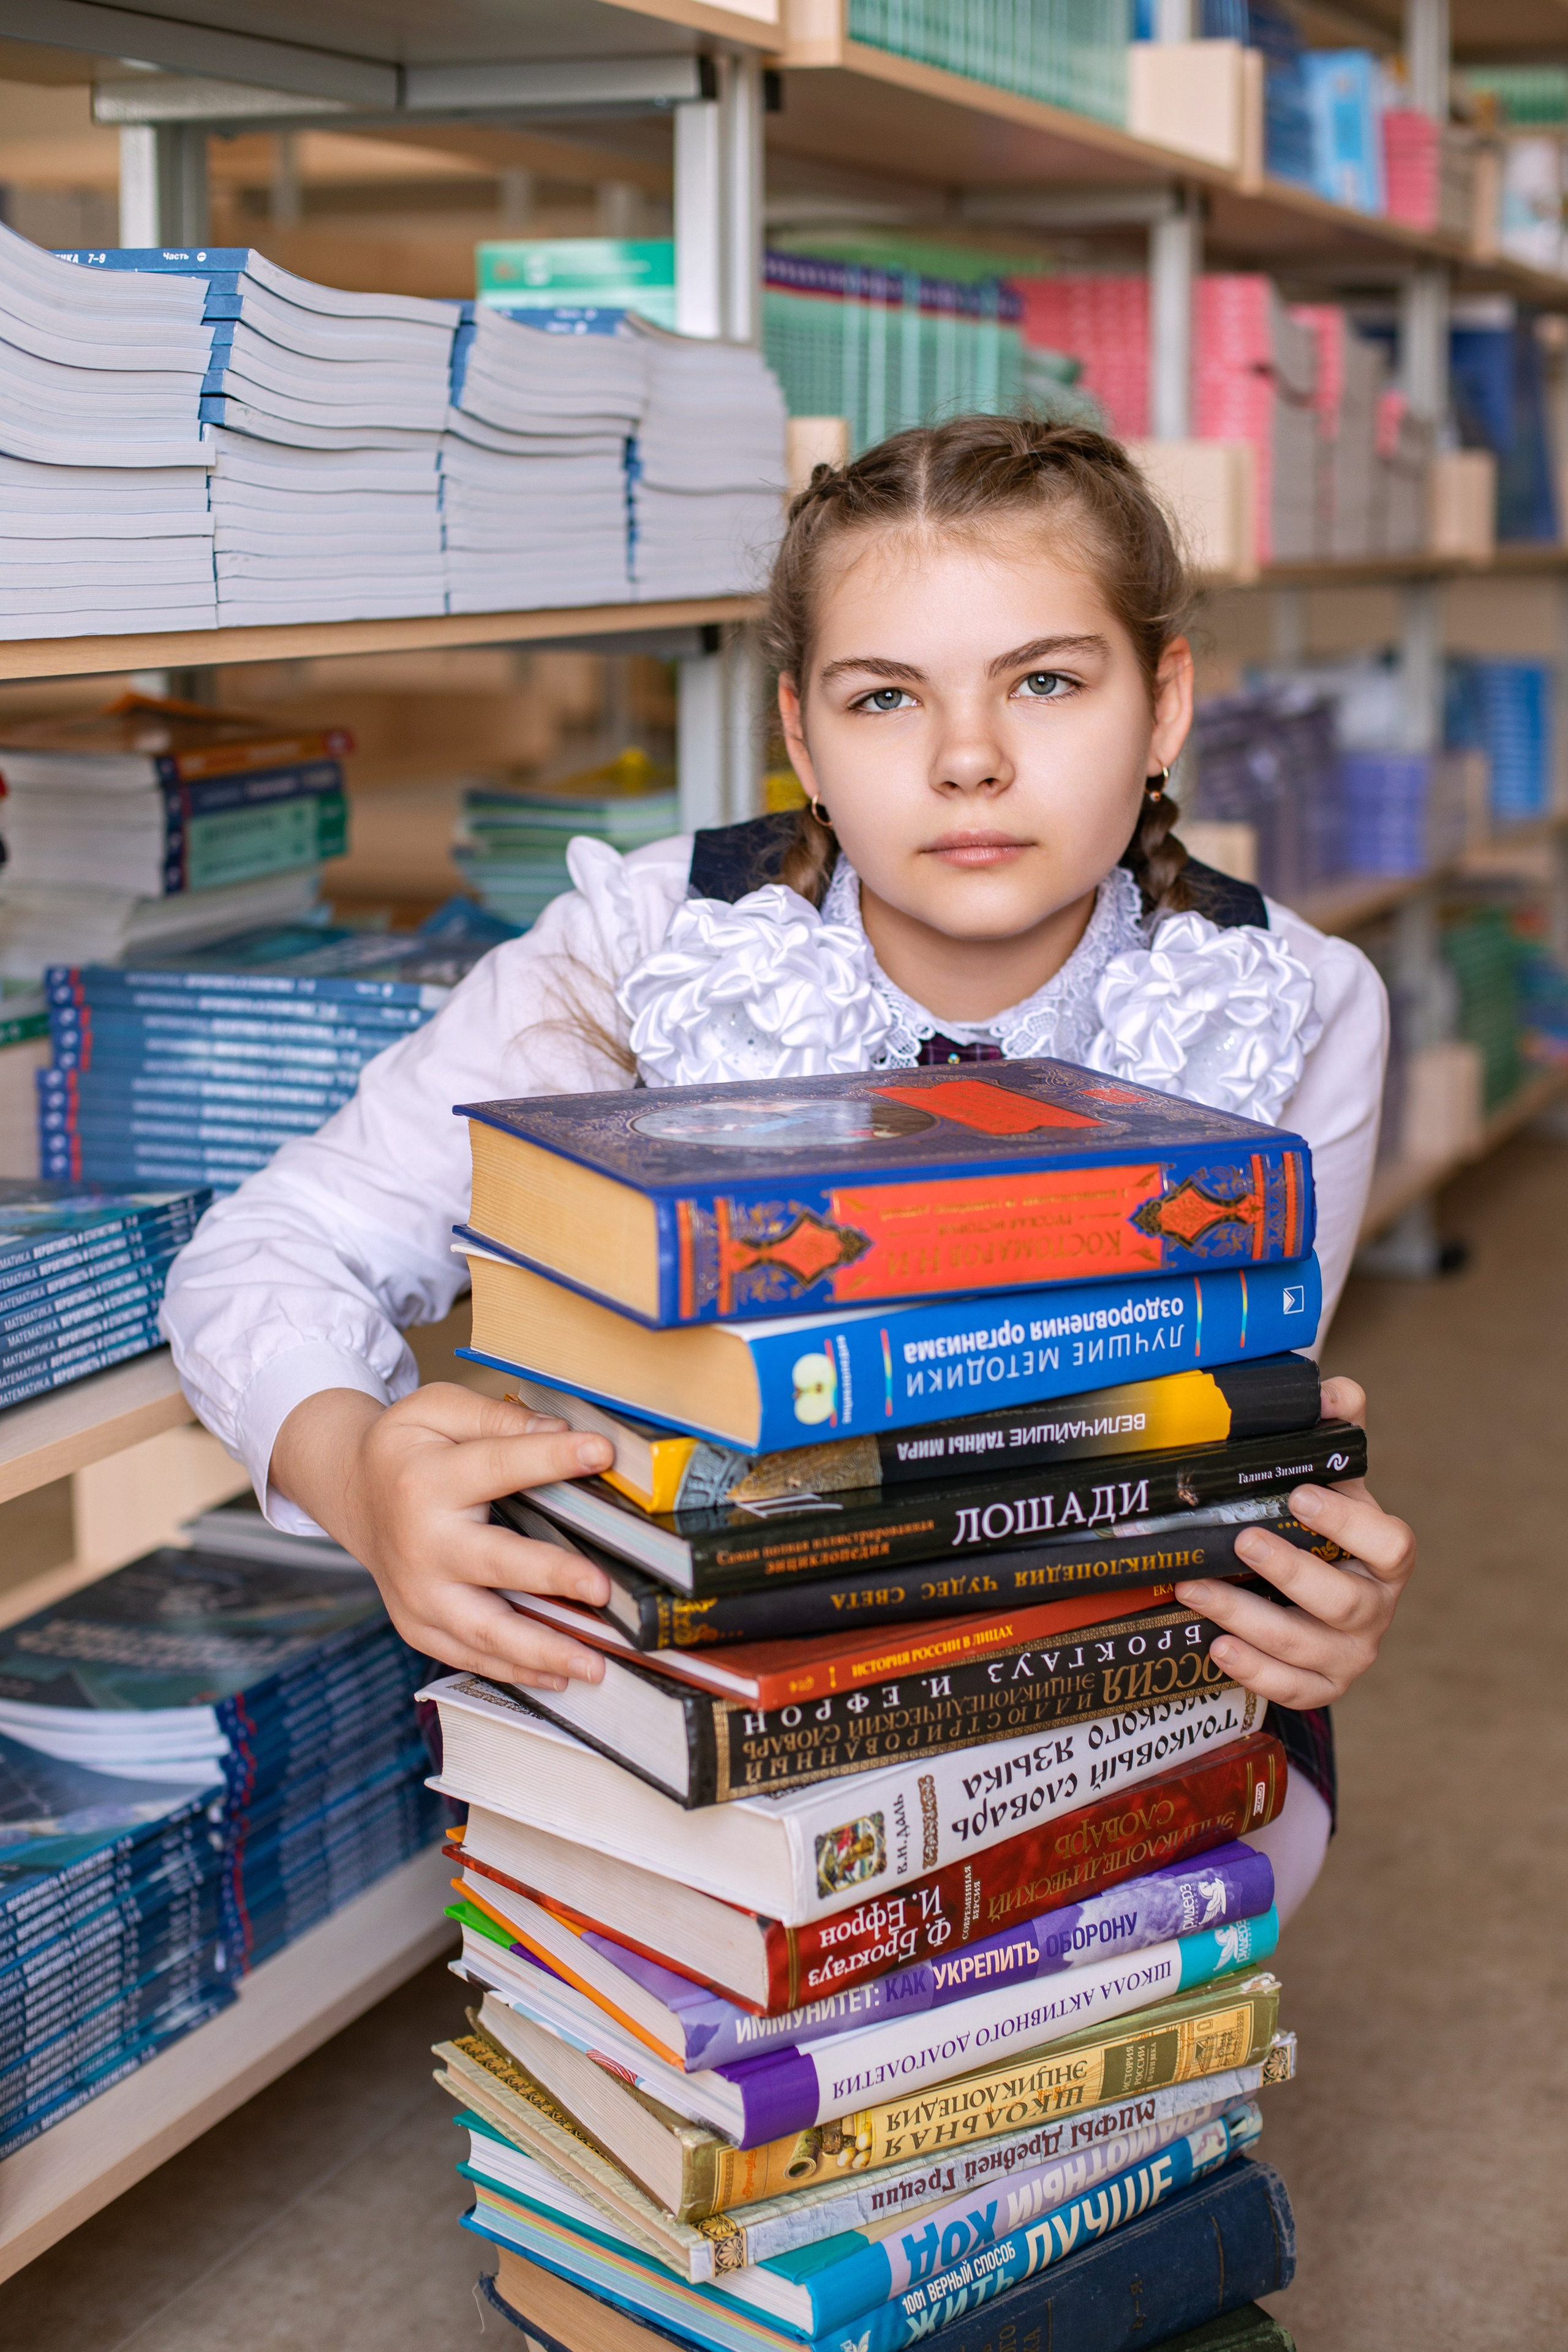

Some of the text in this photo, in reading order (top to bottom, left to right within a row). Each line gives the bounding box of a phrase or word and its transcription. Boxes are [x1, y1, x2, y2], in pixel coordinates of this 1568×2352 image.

[162, 252, 190, 261] Часть
[904, 1297, 1184, 1364] оздоровления организма
[906, 1324, 1185, 1398] ЛУЧШИЕ МЕТОДИКИ
[897, 1412, 1146, 1461] ВЕЛИЧАЙШИЕ ТАЙНЫ МИРА
[1238, 1462, 1314, 1485] Галина Зимина
[812, 1518, 935, 1552] иллюстрированная
[951, 1479, 1150, 1547] ЛОШАДИ
[764, 1541, 891, 1576] энциклопедия
[829, 1548, 1206, 1611] ЭНЦИКЛОПЕДИЯ ЧУДЕС СВЕТА
[851, 1624, 1015, 1679] ИСТОРИЯ РОССИИ В ЛИЦАХ
[987, 1624, 1203, 1684] БРОКГАУЗ
[1102, 1652, 1224, 1705] ОССИЯ
[742, 1684, 901, 1737] ЕФРОН
[742, 1672, 1096, 1762] ЭНЦИКЛОПЕДИЧЕСКИЙ СЛОВАРЬ
[744, 1692, 1093, 1785] ИЛЛЮСТРИРОВАННЫЙ
[1054, 1798, 1175, 1861] СЛОВАРЬ
[987, 1809, 1237, 1922] ЭНЦИКЛОПЕДИЧЕСКИЙ
[819, 1884, 943, 1950] И. Ефрон
[961, 1864, 972, 1940] СОВРЕМЕННАЯ
[971, 1879, 982, 1921] ВЕРСИЯ
[735, 1911, 1138, 2045] ИММУНИТЕТ: КАК УКРЕПИТЬ ОБОРОНУ
[807, 1917, 953, 1988] Ф. Брокгауз
[832, 1960, 1172, 2100] ШКОЛА АКТИВНОГО ДОЛГОЛЕТИЯ
[886, 2059, 1088, 2133] ЭНЦИКЛОПЕДИЯ
[1121, 2044, 1134, 2092] ИСТОРИЯ
[1134, 2044, 1146, 2086] РОССИИ
[883, 2084, 1086, 2159] ШКОЛЬНАЯ
[963, 2124, 1063, 2184] Древней
[1006, 2105, 1212, 2231] ГРАМОТНЫЙ
[871, 2171, 957, 2212] Греции
[900, 2240, 1017, 2316] 1001 ВЕРНЫЙ СПОСОБ
[904, 2155, 1174, 2350] ЖИТЬ ЛУЧШЕ
